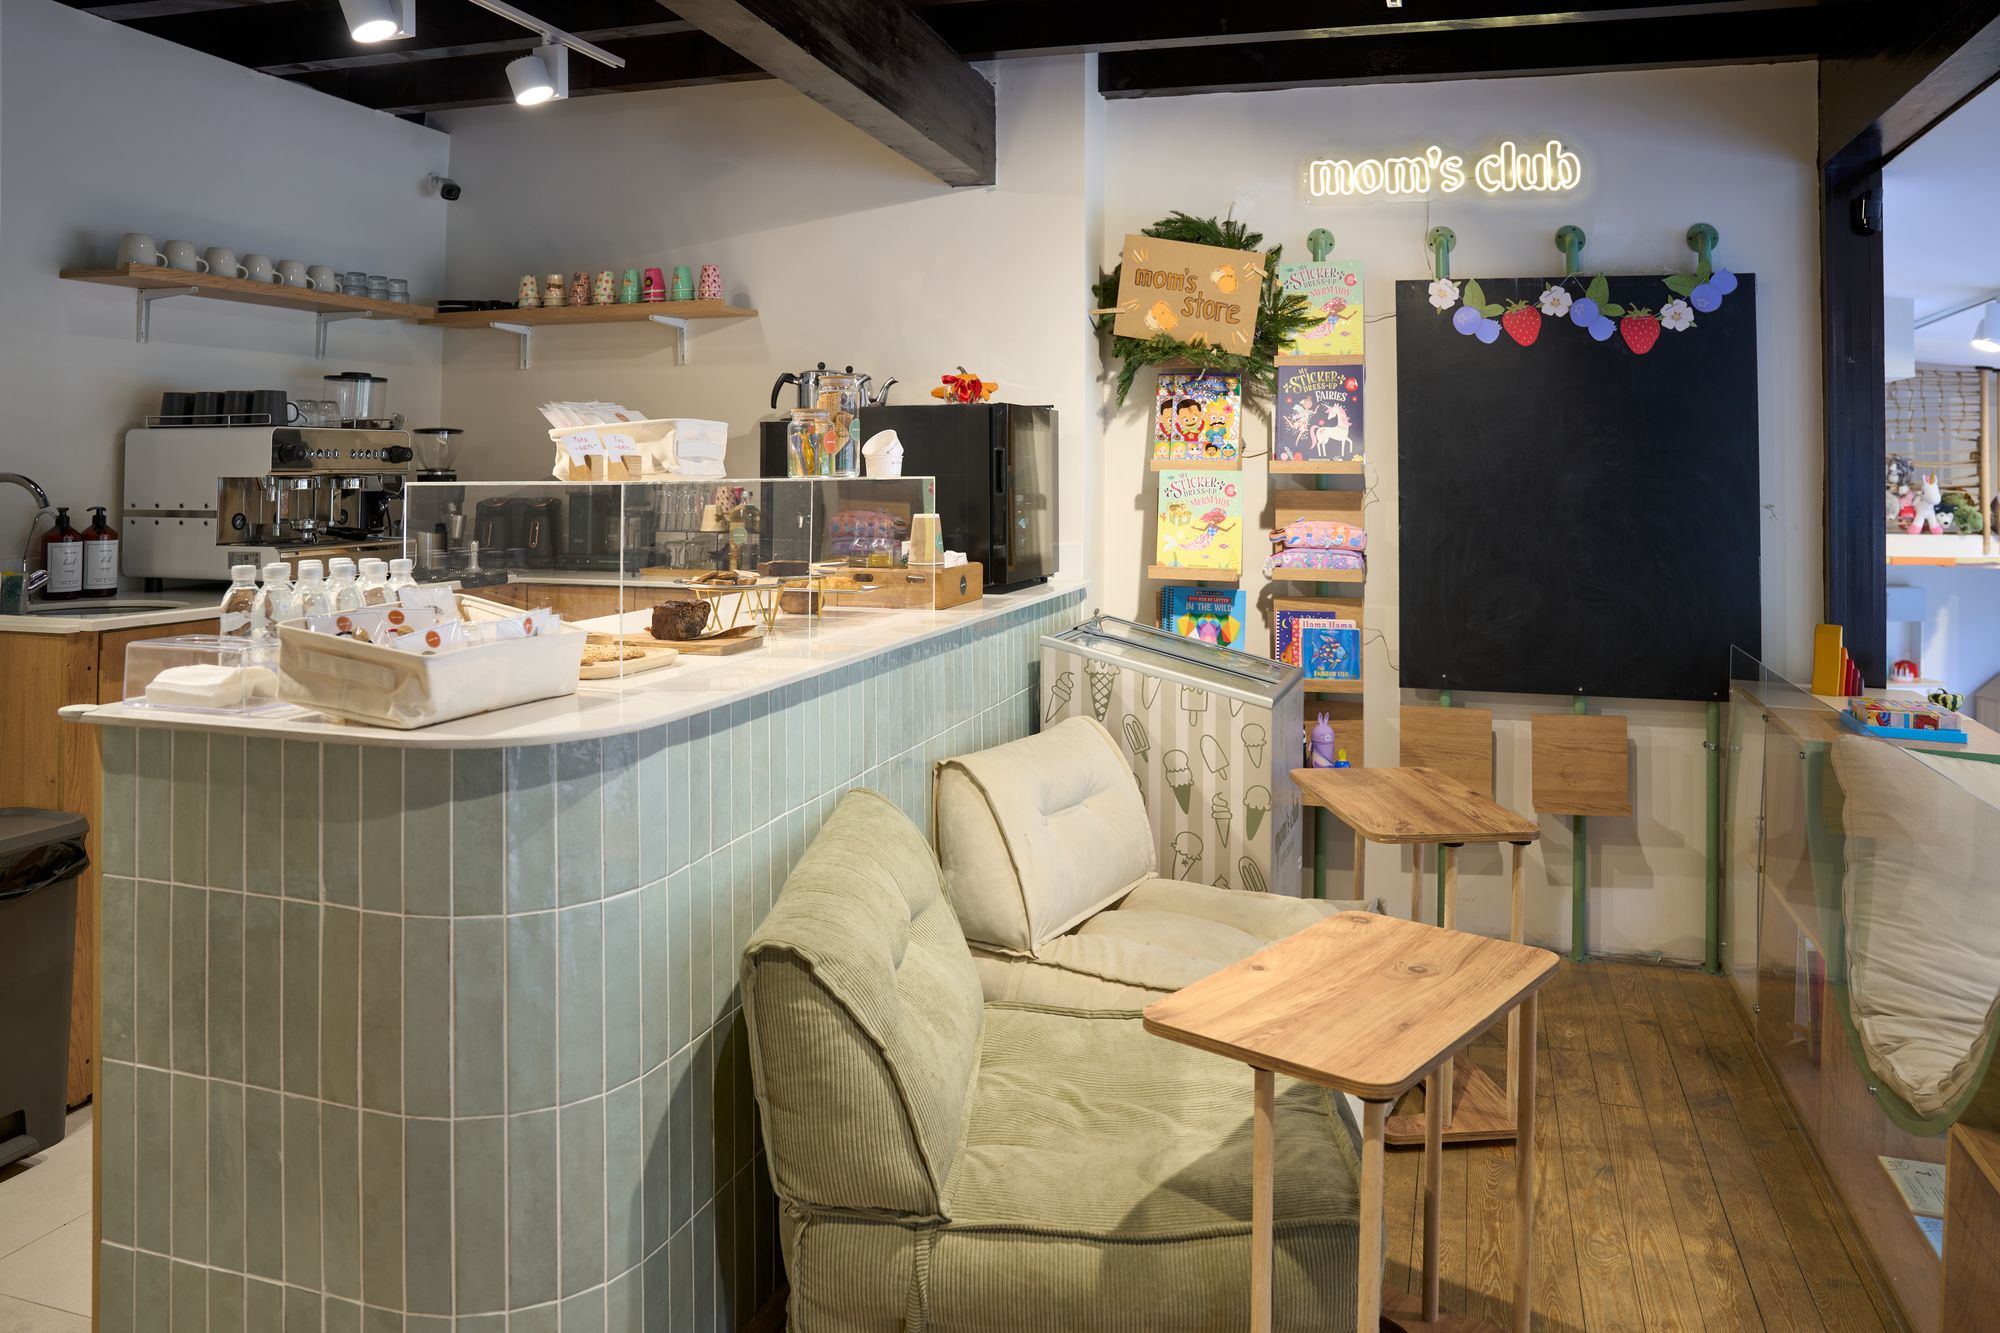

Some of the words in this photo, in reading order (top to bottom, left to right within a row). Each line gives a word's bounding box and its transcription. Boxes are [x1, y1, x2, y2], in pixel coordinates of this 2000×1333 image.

[1310, 145, 1465, 196] mom's
[1475, 140, 1581, 192] club
[1134, 268, 1199, 294] mom's
[1290, 267, 1337, 290] STICKER
[1181, 291, 1241, 325] store
[1289, 370, 1338, 394] STICKER
[1303, 382, 1338, 393] DRESS-UP
[1315, 390, 1348, 402] FAIRIES
[1170, 476, 1218, 499] STICKER
[1185, 603, 1194, 611] IN
[1197, 603, 1212, 612] THE
[1214, 603, 1233, 613] WILD
[1302, 620, 1327, 629] llama
[1329, 621, 1353, 630] llama
